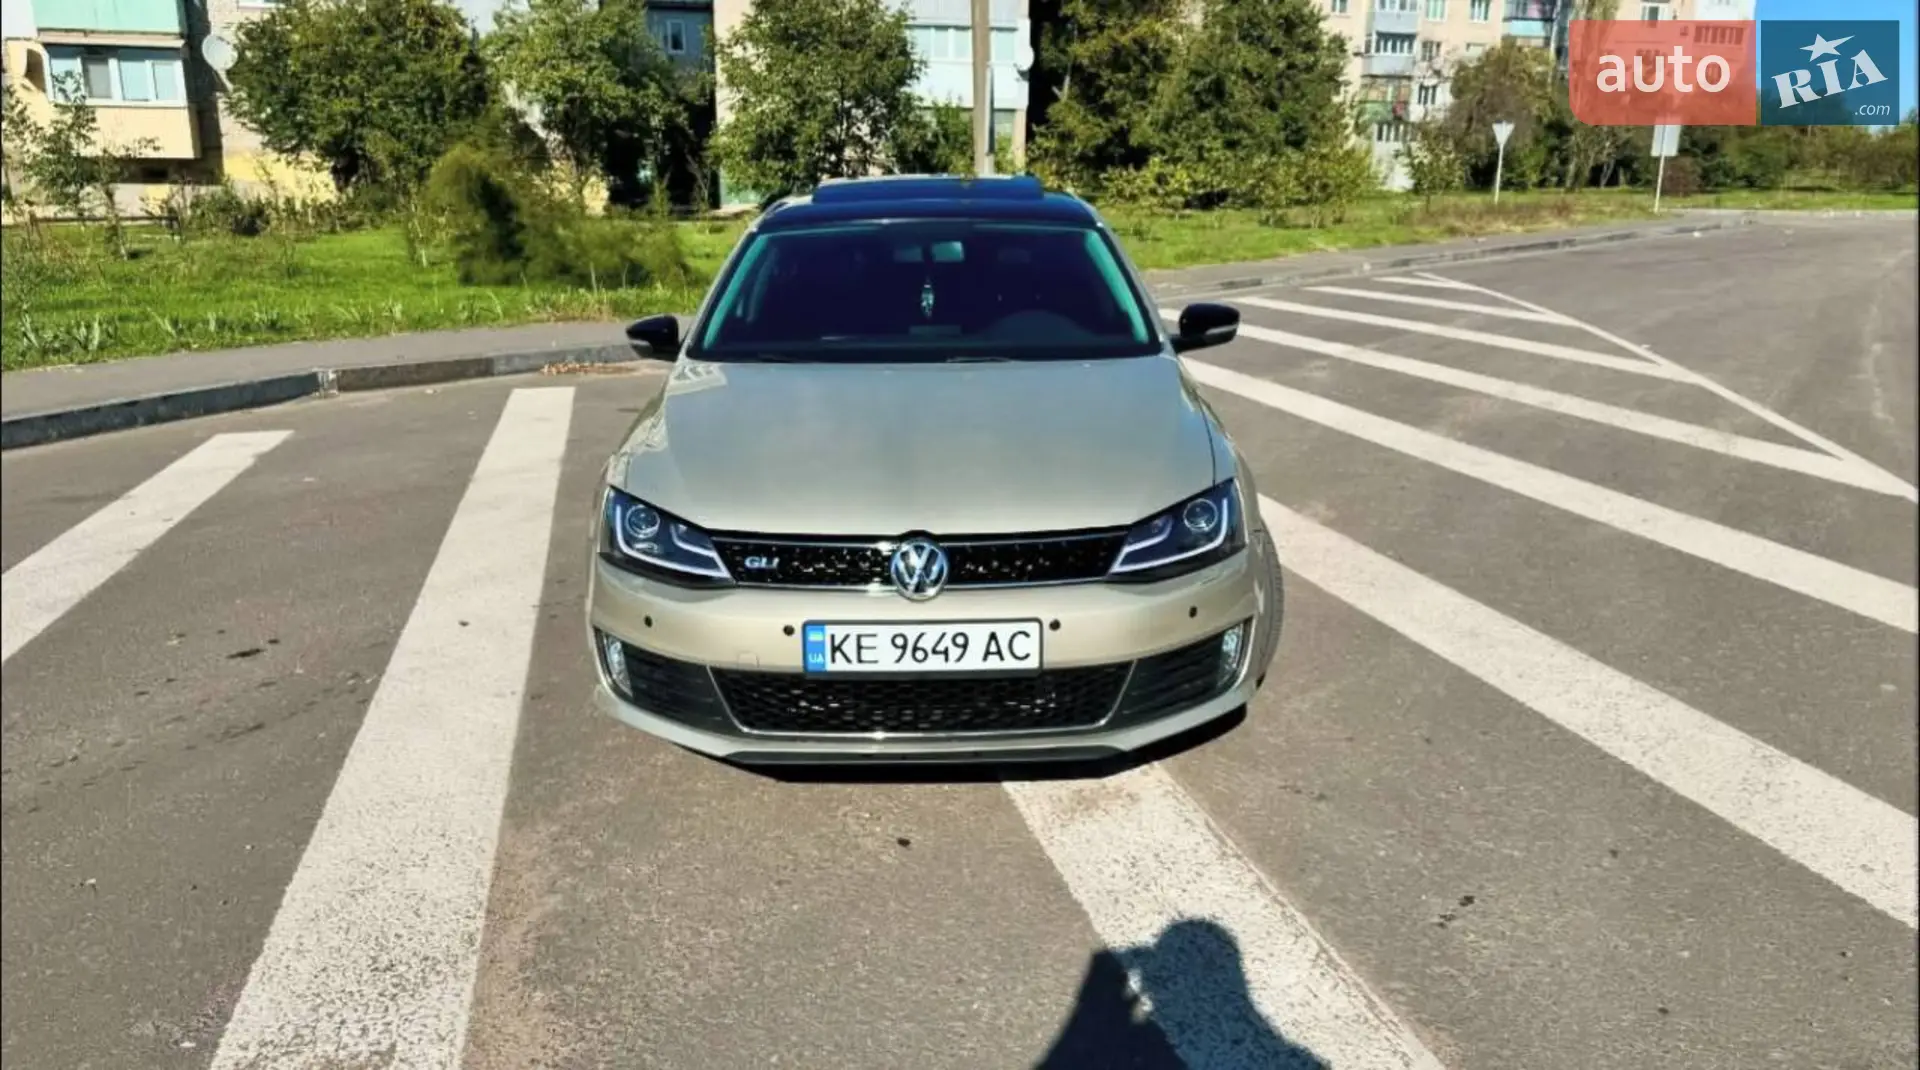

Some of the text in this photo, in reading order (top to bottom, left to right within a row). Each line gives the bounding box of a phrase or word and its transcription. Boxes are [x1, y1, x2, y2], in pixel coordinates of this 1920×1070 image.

[744, 556, 780, 569] GLI
[830, 630, 1031, 664] KE 9649 AC
[808, 653, 825, 664] UA
